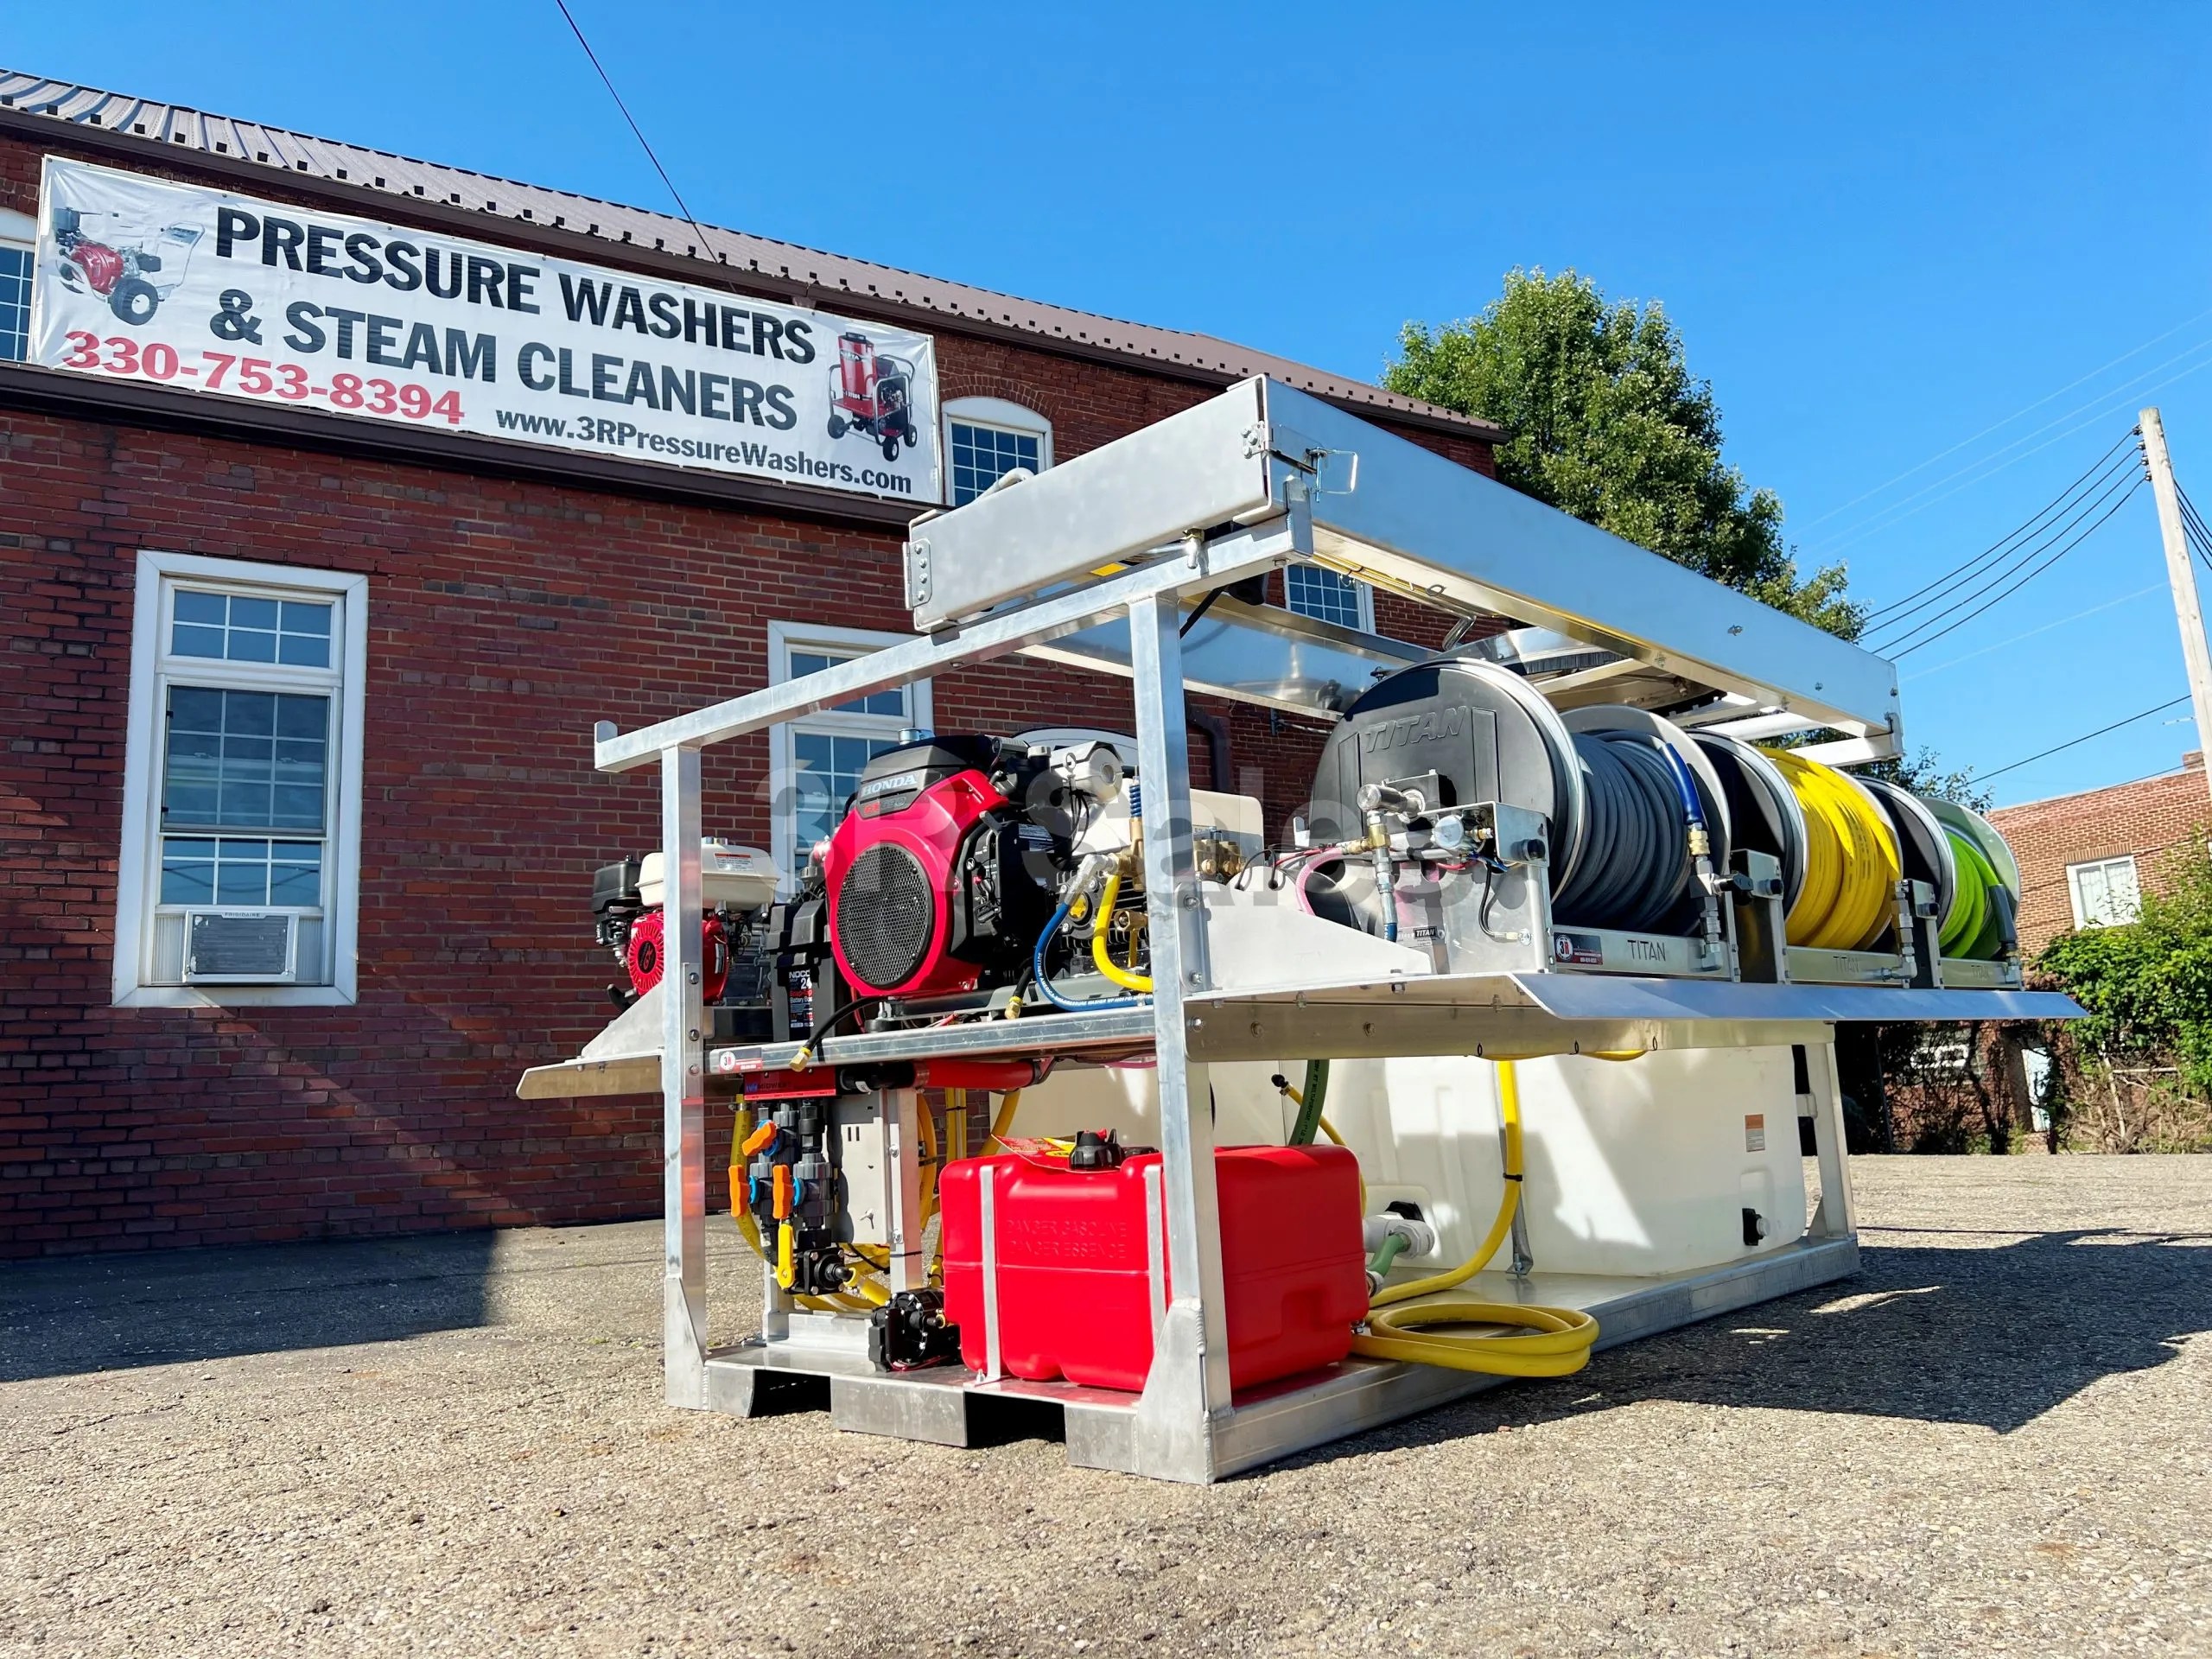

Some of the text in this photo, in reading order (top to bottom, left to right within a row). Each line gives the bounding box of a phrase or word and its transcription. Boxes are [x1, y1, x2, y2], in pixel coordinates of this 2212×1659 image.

[216, 206, 816, 365] PRESSURE WASHERS
[209, 289, 798, 431] & STEAM CLEANERS
[61, 330, 465, 425] 330-753-8394
[495, 410, 912, 494] www.3RPressureWashers.com
[1364, 705, 1468, 753] TITAN
[861, 774, 918, 798] HONDA
[1415, 928, 1435, 938] TITAN
[1559, 941, 1570, 956] 3R
[1627, 939, 1667, 962] TITAN
[1833, 956, 1859, 974] TITAN
[1006, 1219, 1058, 1236] DANGER
